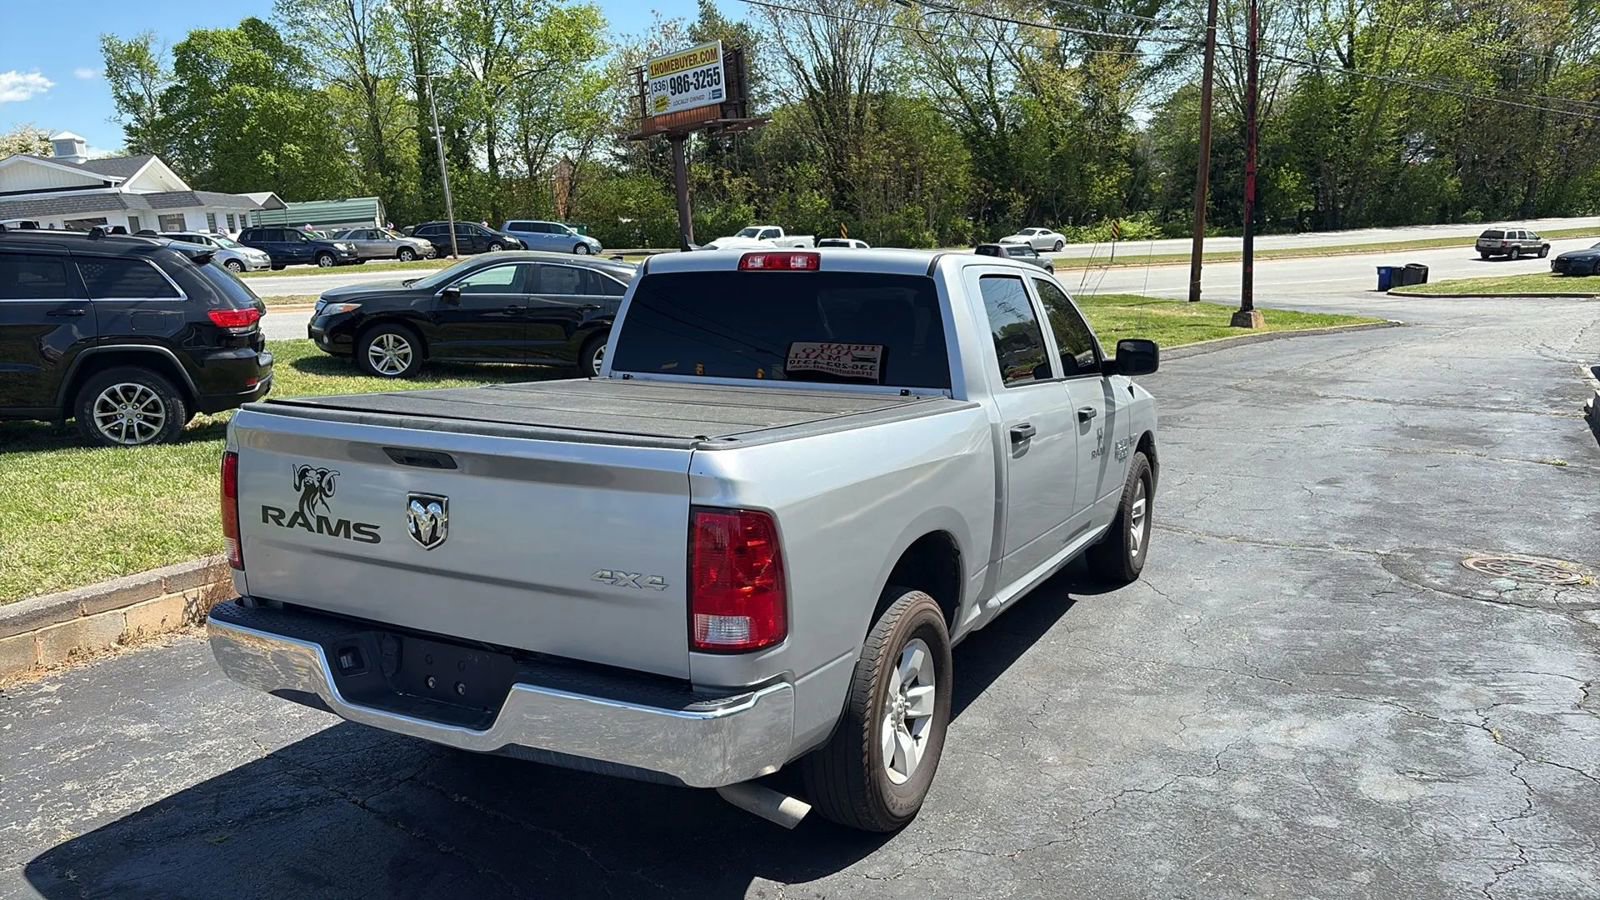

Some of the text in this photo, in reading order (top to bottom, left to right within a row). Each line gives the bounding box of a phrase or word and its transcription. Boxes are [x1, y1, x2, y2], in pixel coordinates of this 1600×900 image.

[650, 48, 718, 76] 1HOMEBUYER.COM
[652, 80, 669, 95] (336)
[670, 67, 721, 96] 986-3255
[261, 505, 381, 544] RAMS
